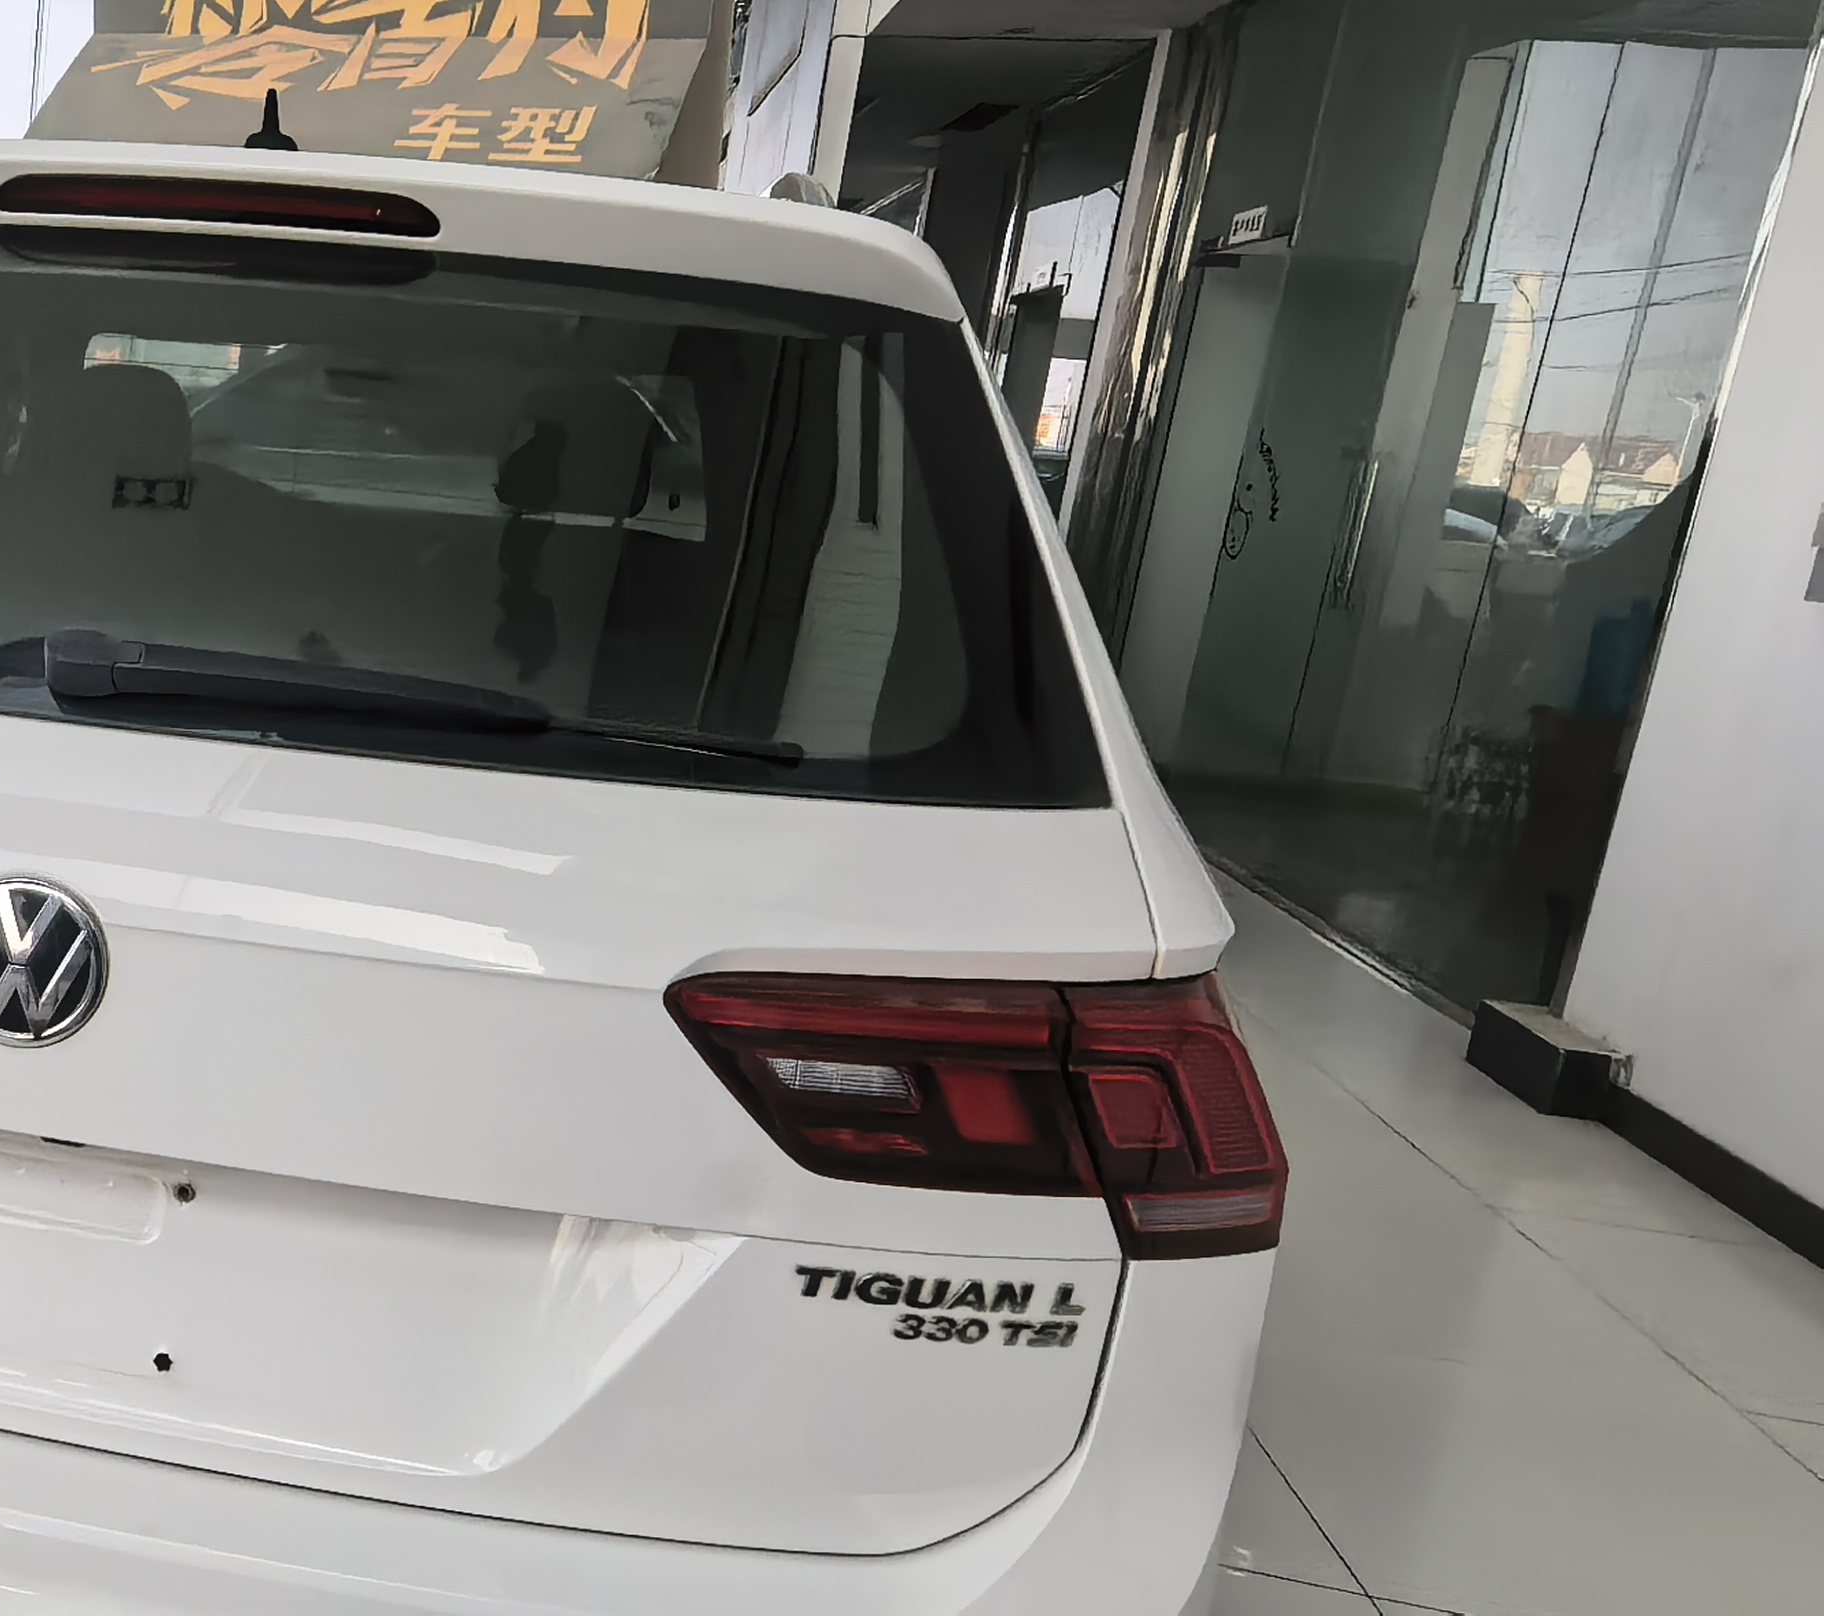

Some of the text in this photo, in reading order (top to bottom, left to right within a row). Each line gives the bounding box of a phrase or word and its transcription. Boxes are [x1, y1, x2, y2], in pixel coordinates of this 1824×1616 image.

[393, 103, 597, 162] 车型
[795, 1264, 1086, 1316] TIGUAN L
[892, 1313, 1078, 1348] 330 TSI
